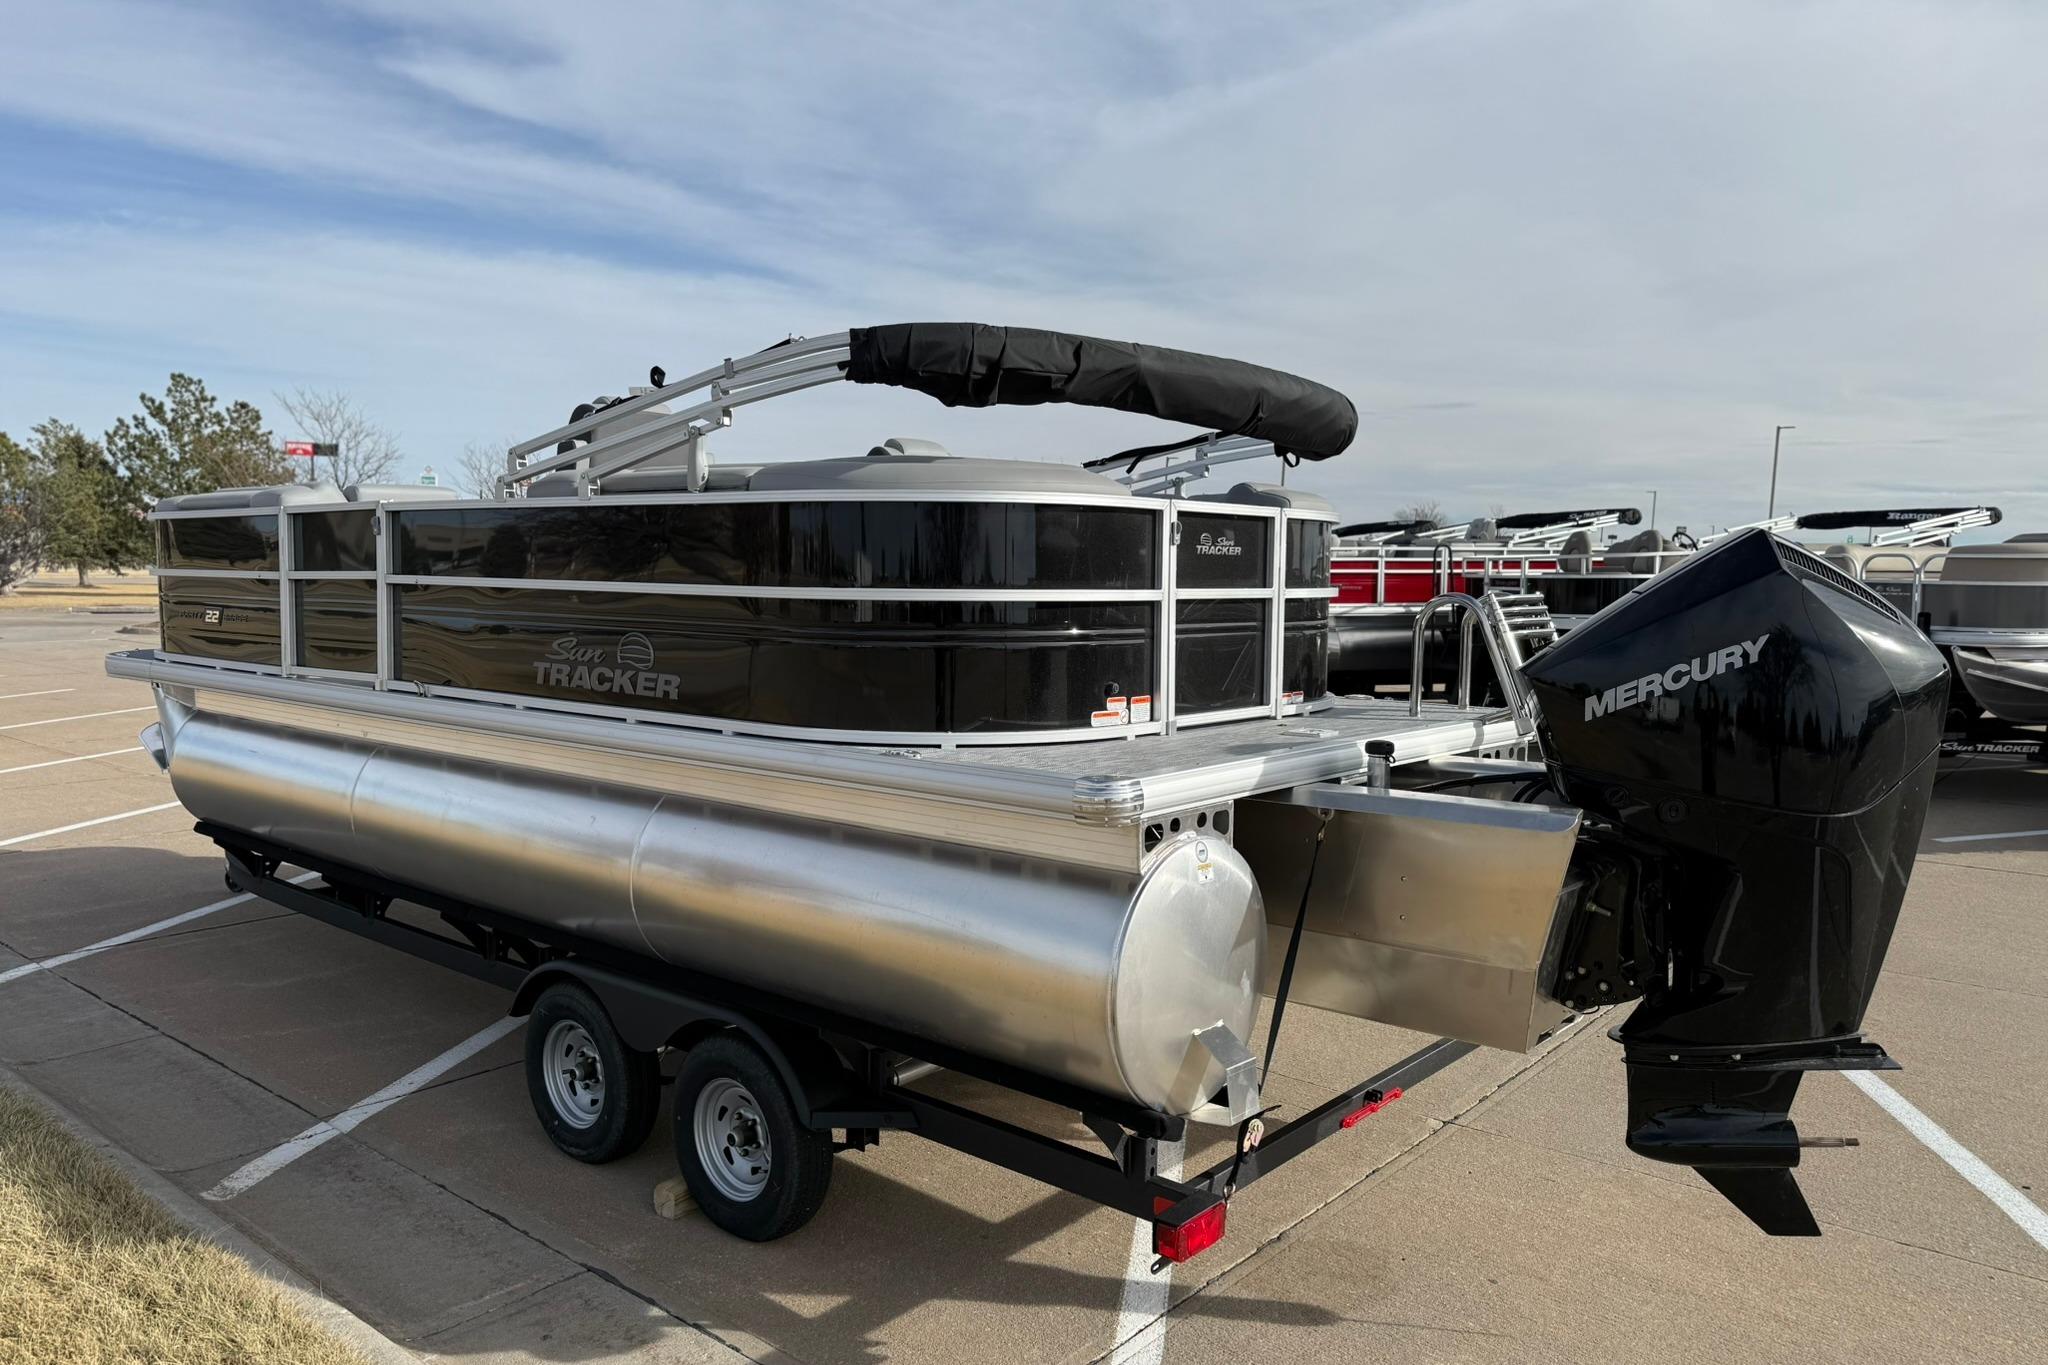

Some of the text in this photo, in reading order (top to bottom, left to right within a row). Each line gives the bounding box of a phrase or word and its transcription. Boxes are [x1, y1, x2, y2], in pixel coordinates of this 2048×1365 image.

[1214, 536, 1235, 546] Sun
[1196, 545, 1242, 556] TRACKER
[204, 609, 220, 623] 22
[545, 636, 606, 664] Sun
[532, 661, 681, 700] TRACKER
[1584, 633, 1770, 722] MERCURY
[1940, 742, 2040, 753] Sun TRACKER
